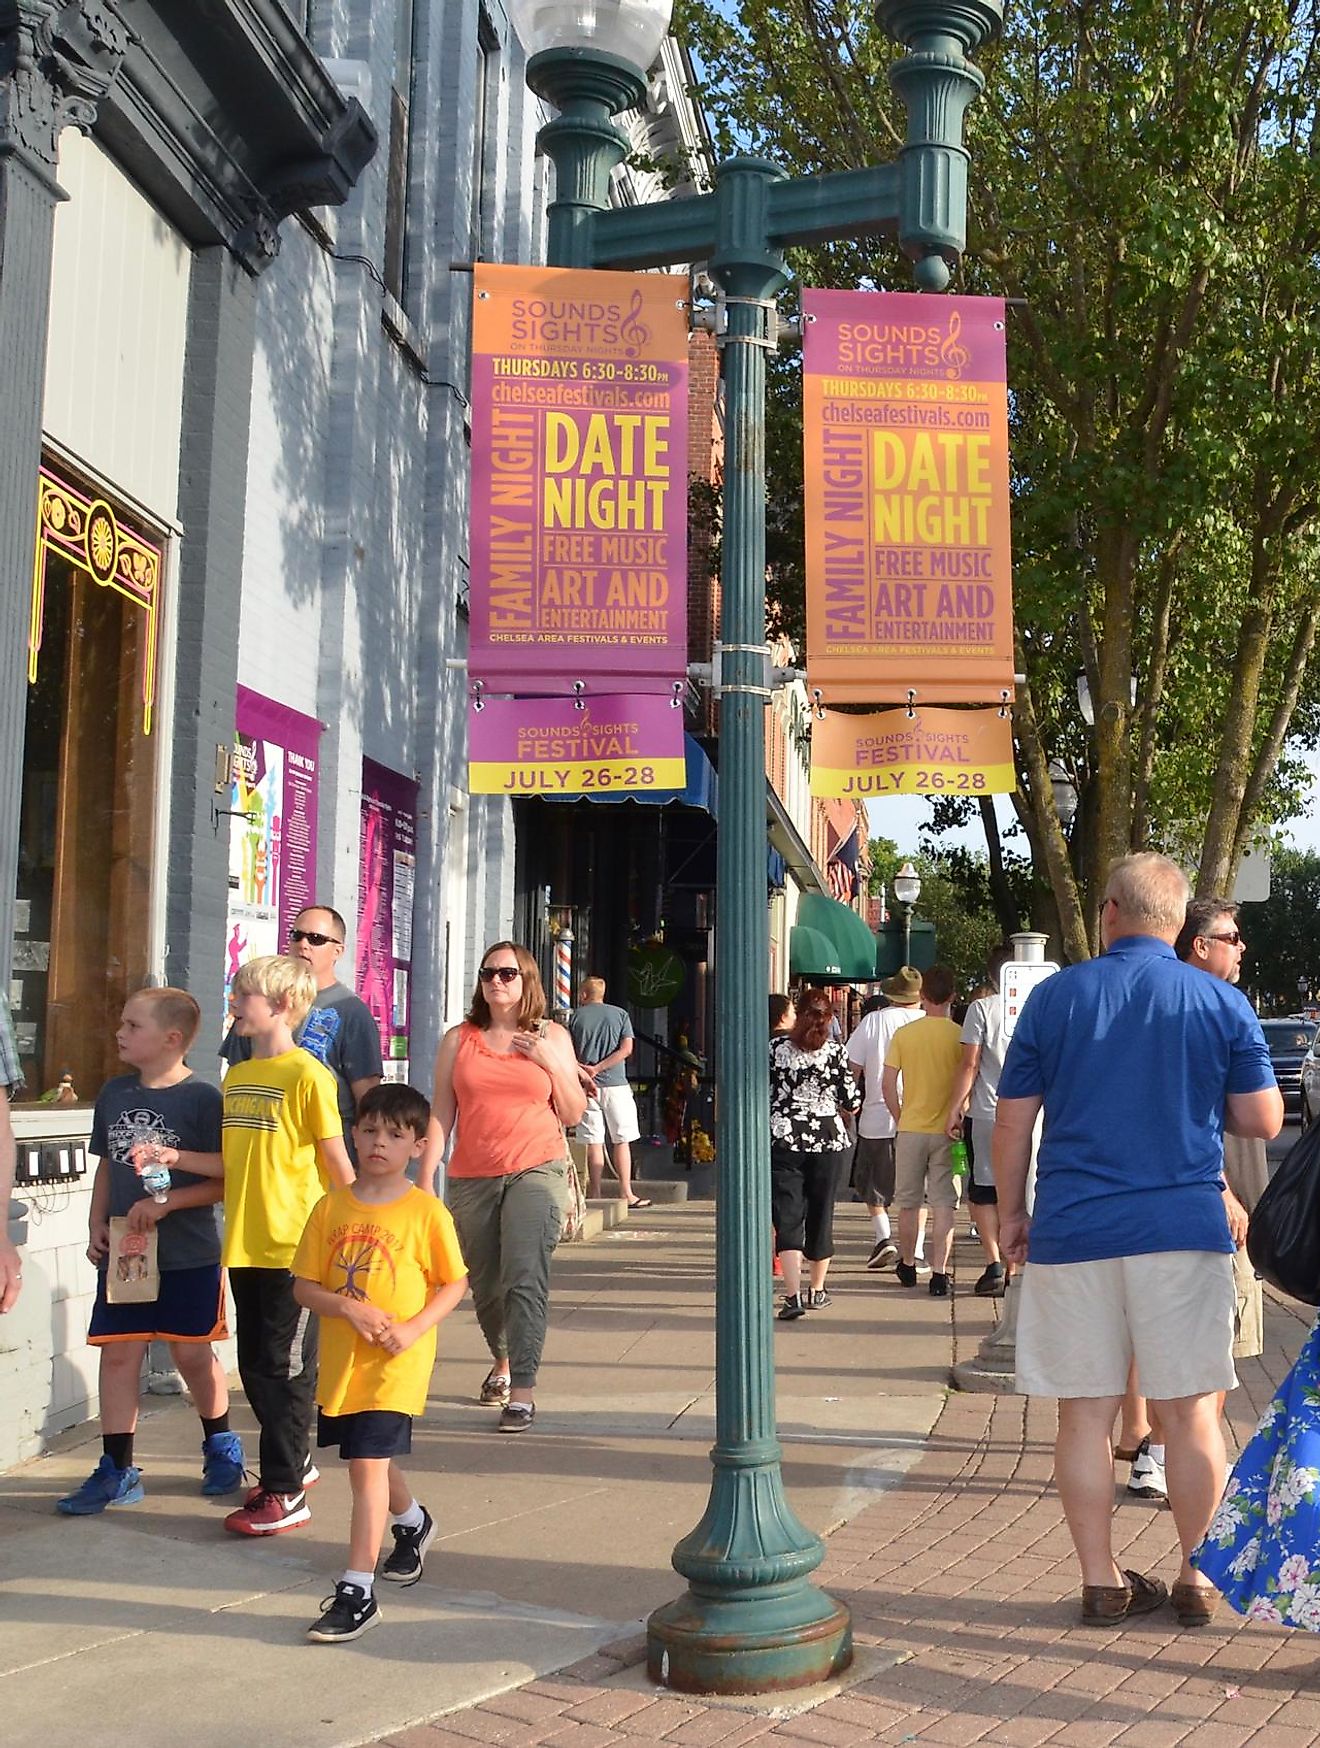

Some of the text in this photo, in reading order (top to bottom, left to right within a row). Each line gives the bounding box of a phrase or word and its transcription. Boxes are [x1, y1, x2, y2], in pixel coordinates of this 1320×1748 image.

[512, 300, 620, 322] SOUNDS
[511, 320, 618, 344] SIGHTS
[838, 323, 941, 345] SOUNDS
[510, 343, 525, 351] ON
[530, 344, 582, 354] THURSDAY
[838, 343, 940, 366] SIGHTS
[493, 358, 578, 379] THURSDAYS
[838, 364, 853, 372] ON
[856, 365, 906, 374] THURSDAY
[492, 381, 670, 408] chelseafestivals.com
[822, 380, 903, 398] THURSDAYS
[822, 402, 990, 428] chelseafestivals.com
[545, 412, 670, 476] DATE
[874, 431, 992, 494] DATE
[544, 477, 670, 530] NIGHT
[490, 409, 534, 627] FAMILY NIGHT
[874, 494, 992, 545] NIGHT
[823, 428, 865, 639] FAMILY NIGHT
[543, 535, 667, 564] FREE MUSIC
[875, 550, 992, 577] FREE MUSIC
[542, 570, 669, 607] ART AND
[875, 583, 994, 618] ART AND
[542, 609, 668, 630] ENTERTAINMENT
[489, 634, 668, 644] CHELSEA AREA FESTIVALS & EVENTS
[875, 621, 995, 641] ENTERTAINMENT
[826, 645, 868, 654] CHELSEA
[959, 646, 994, 655] EVENTS
[518, 723, 638, 738] SOUNDS SIGHTS
[856, 733, 969, 748] SOUNDS SIGHTS
[517, 737, 639, 758] FESTIVAL
[856, 744, 970, 766] FESTIVAL
[504, 767, 654, 788] JULY 26-28
[843, 771, 985, 792] JULY 26-28
